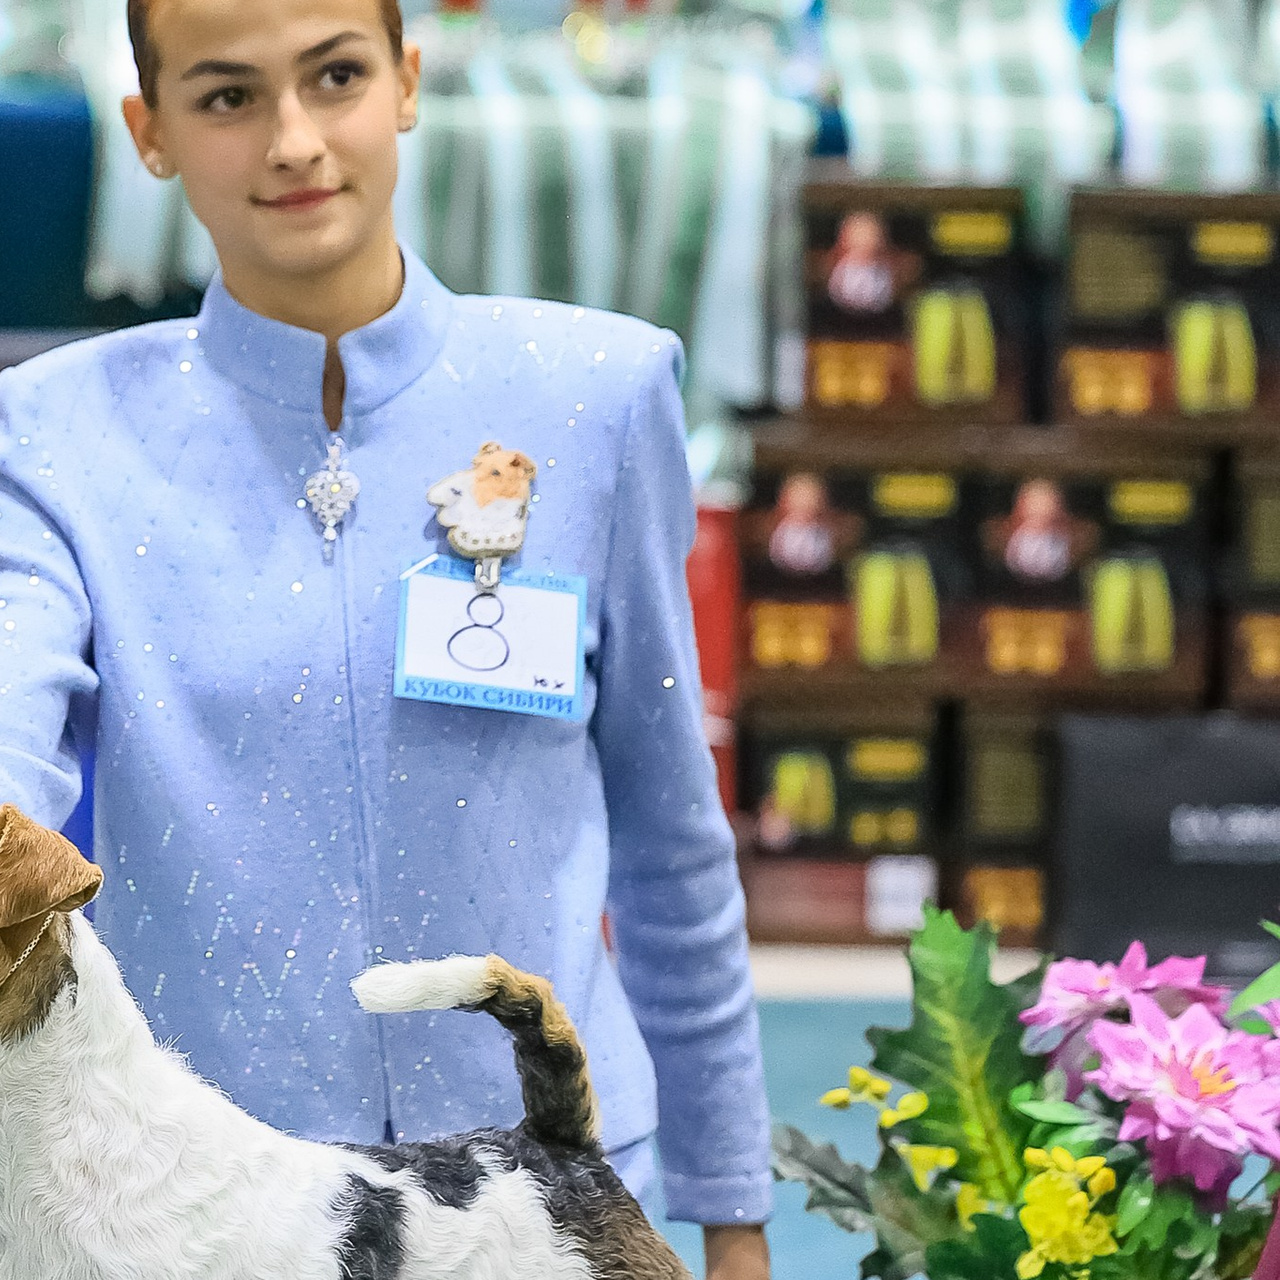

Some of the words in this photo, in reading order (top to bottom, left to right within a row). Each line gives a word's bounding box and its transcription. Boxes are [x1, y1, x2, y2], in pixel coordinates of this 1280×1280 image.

[446, 591, 510, 671] 8
[404, 677, 477, 702] КУБОК
[481, 683, 574, 715] СИБИРИ
